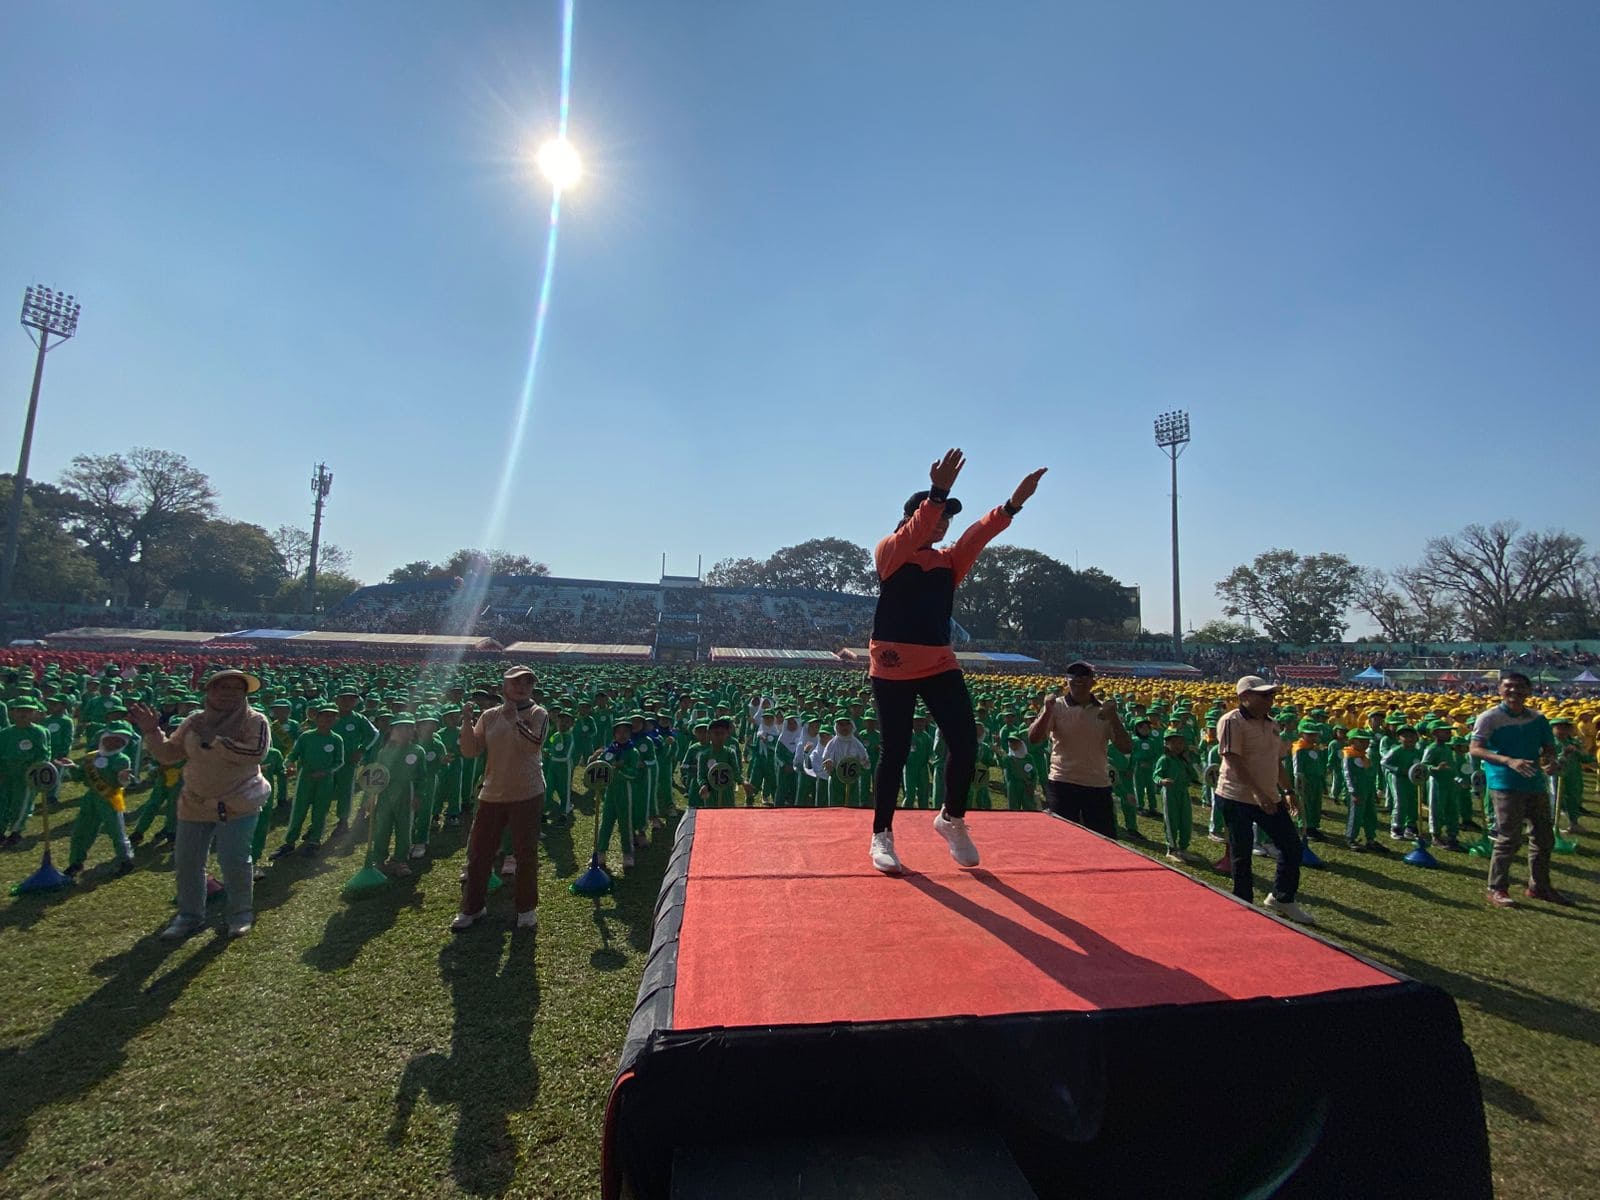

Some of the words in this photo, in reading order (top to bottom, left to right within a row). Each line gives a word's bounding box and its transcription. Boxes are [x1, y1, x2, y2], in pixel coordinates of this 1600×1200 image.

[28, 767, 53, 787] 10
[362, 769, 385, 786] 12
[587, 767, 609, 784] 14
[711, 768, 729, 785] 15
[839, 762, 857, 777] 16
